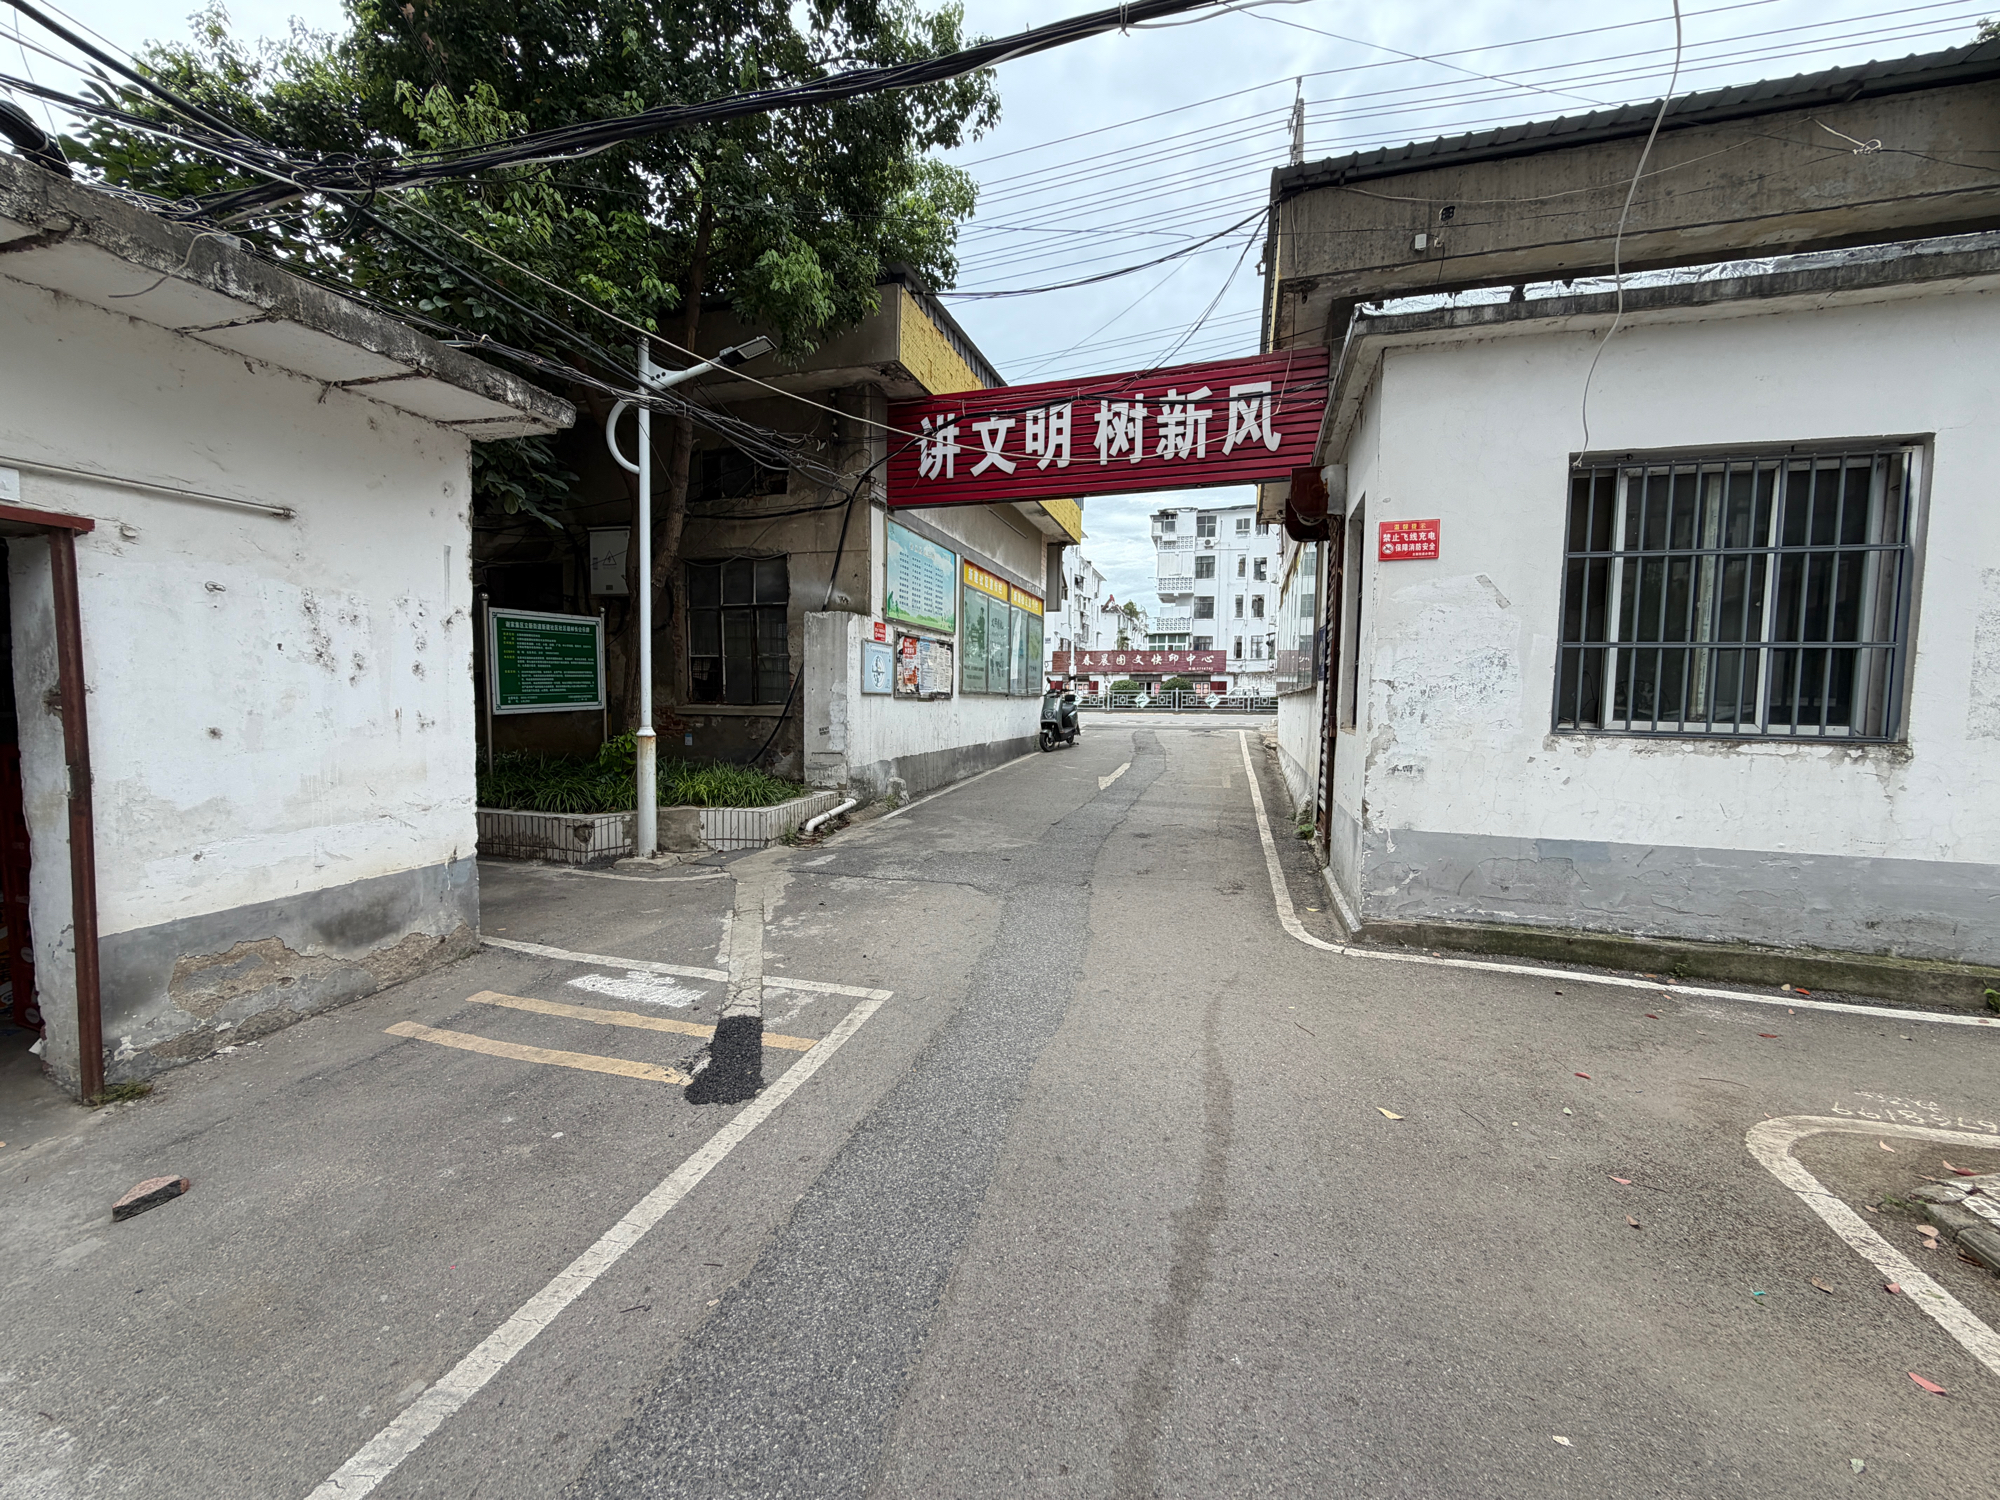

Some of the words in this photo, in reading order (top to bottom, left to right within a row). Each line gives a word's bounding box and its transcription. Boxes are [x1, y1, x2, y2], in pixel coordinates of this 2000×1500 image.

[917, 402, 1072, 481] 讲文明
[1093, 381, 1282, 466] 树新风
[1383, 531, 1436, 542] 禁止飞线充电
[1395, 542, 1436, 552] 保障消防安全
